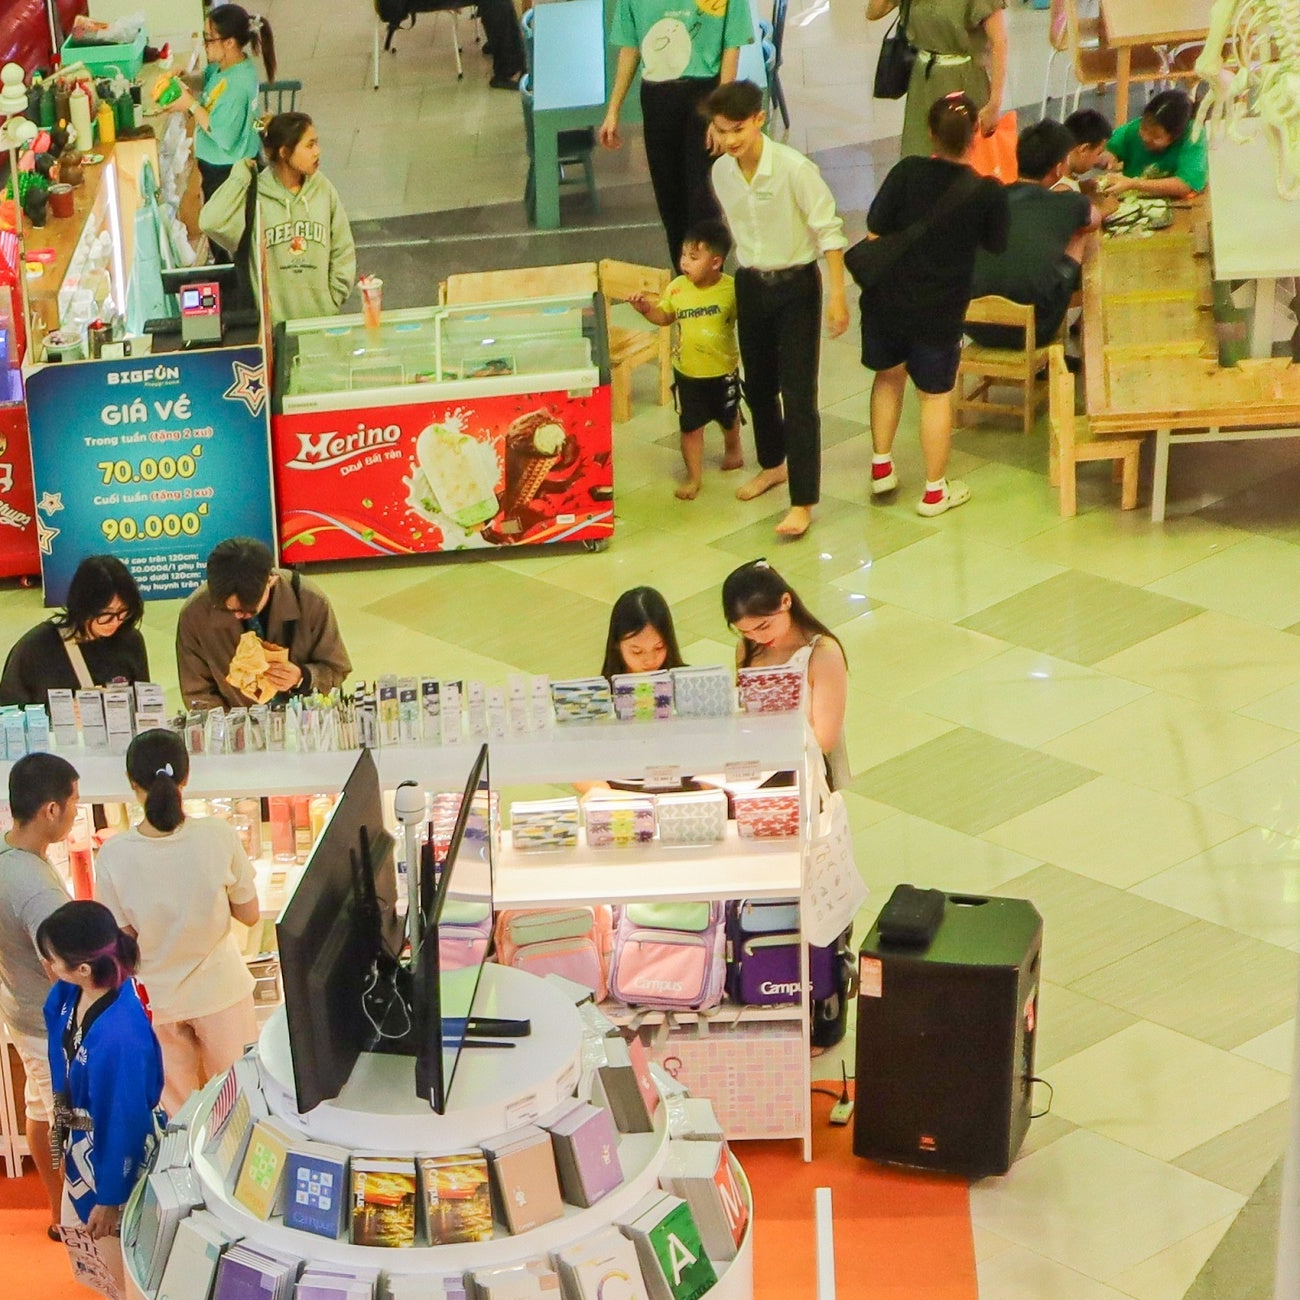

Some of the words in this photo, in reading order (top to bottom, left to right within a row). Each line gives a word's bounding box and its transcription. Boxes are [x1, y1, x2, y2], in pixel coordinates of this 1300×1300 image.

[101, 397, 148, 426] GIÁ
[154, 393, 192, 421] VÉ
[85, 435, 118, 448] Trong
[183, 429, 192, 438] 2
[194, 426, 214, 440] xu)
[292, 423, 402, 464] Merino
[94, 494, 119, 506] Cuối
[184, 488, 192, 498] 2
[195, 487, 214, 499] xu)
[634, 975, 683, 992] Campus
[666, 1232, 698, 1286] A
